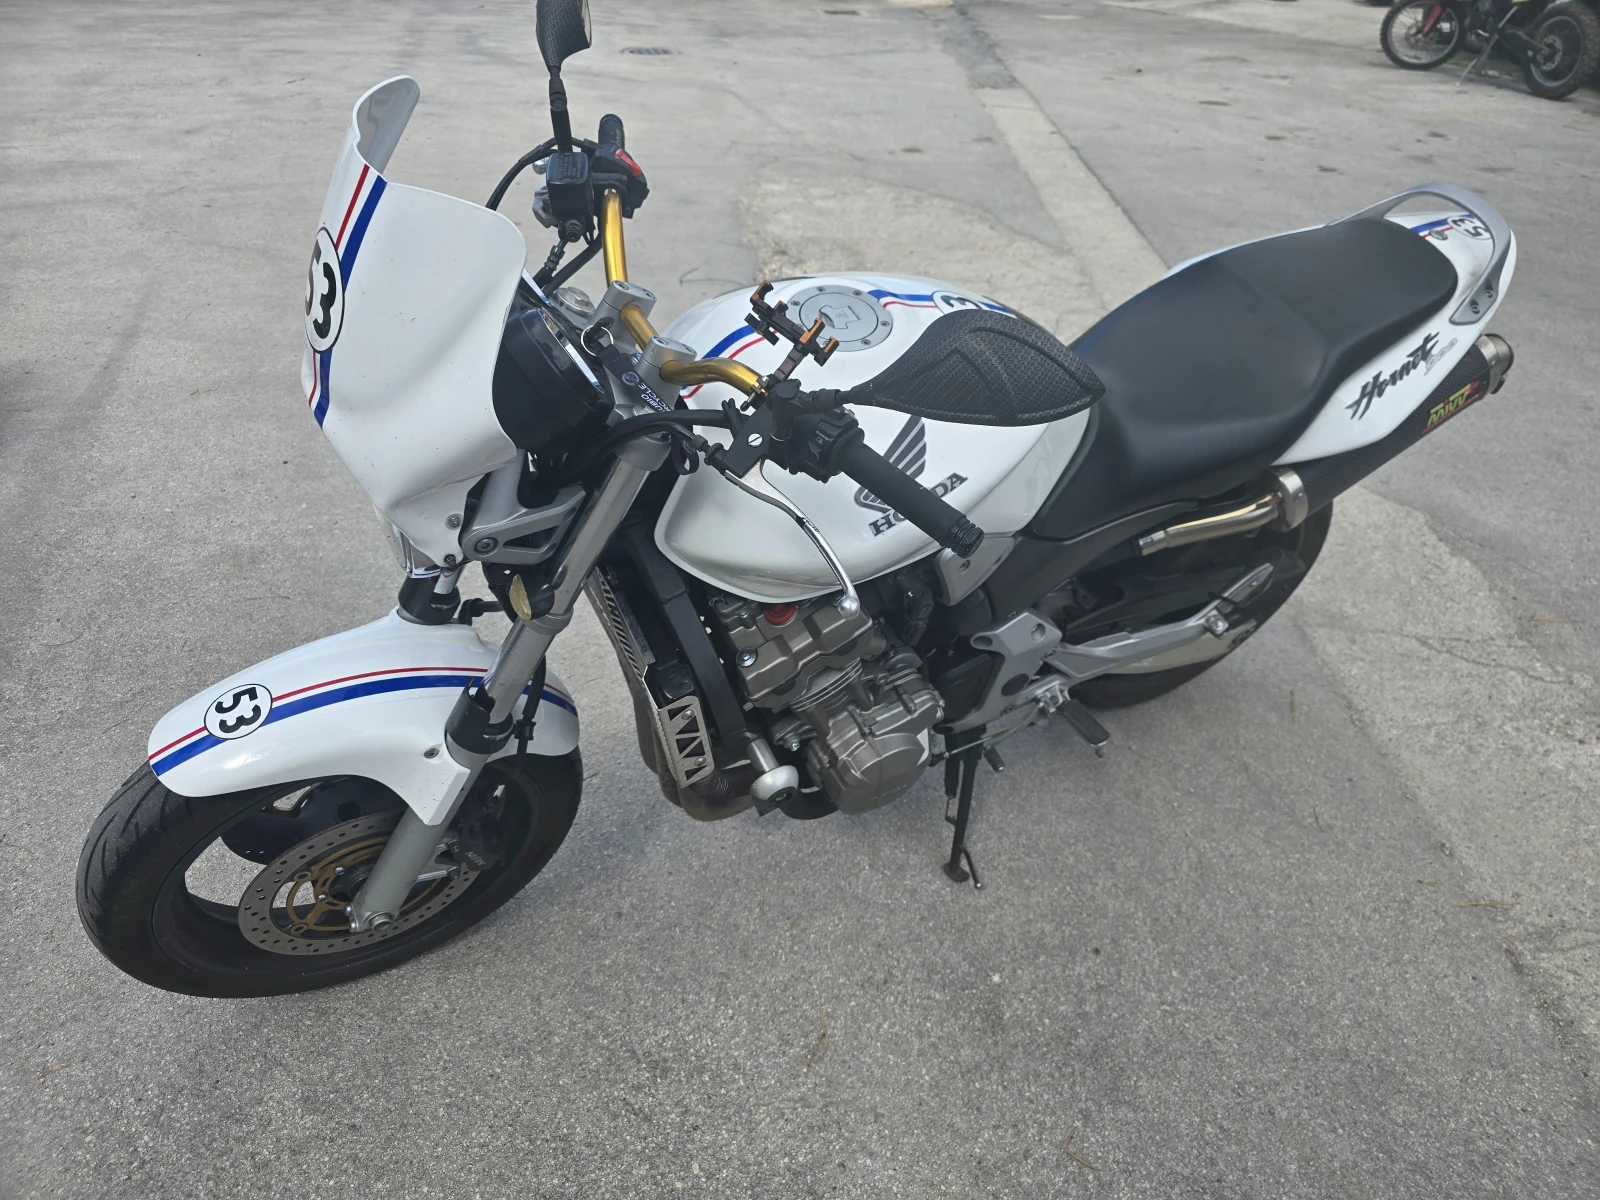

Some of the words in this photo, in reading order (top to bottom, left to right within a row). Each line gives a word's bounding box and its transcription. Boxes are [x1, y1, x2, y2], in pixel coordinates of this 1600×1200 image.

[1451, 218, 1489, 237] 53
[940, 295, 983, 310] 3
[1345, 331, 1440, 420] Hornet
[638, 382, 672, 412] RCYCLE
[641, 393, 666, 413] UBIO
[868, 472, 968, 537] HDA
[214, 686, 262, 734] 53
